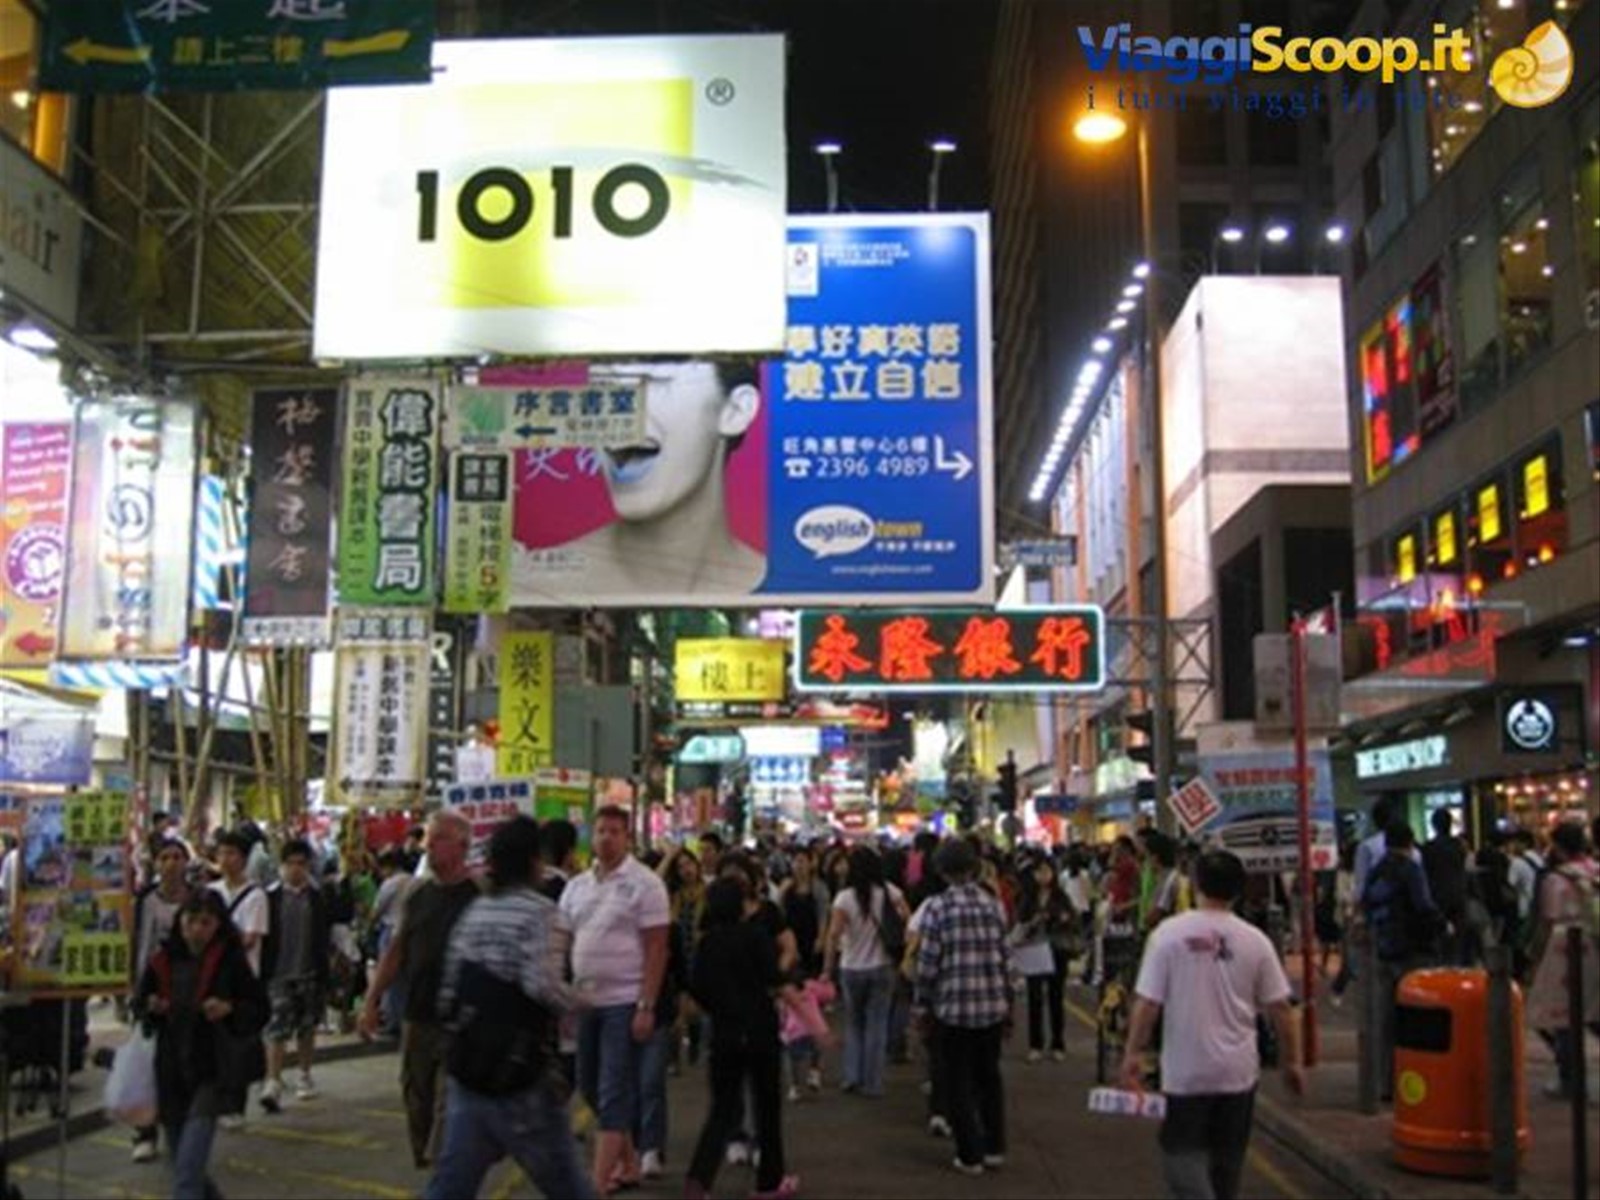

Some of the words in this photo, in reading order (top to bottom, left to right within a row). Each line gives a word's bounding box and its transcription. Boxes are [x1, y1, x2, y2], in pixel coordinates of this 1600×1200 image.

[416, 163, 670, 243] 1010
[783, 359, 962, 401] 建立自信
[817, 457, 870, 478] 2396
[875, 457, 930, 478] 4989
[800, 516, 869, 542] english
[808, 613, 1090, 683] 永隆銀行
